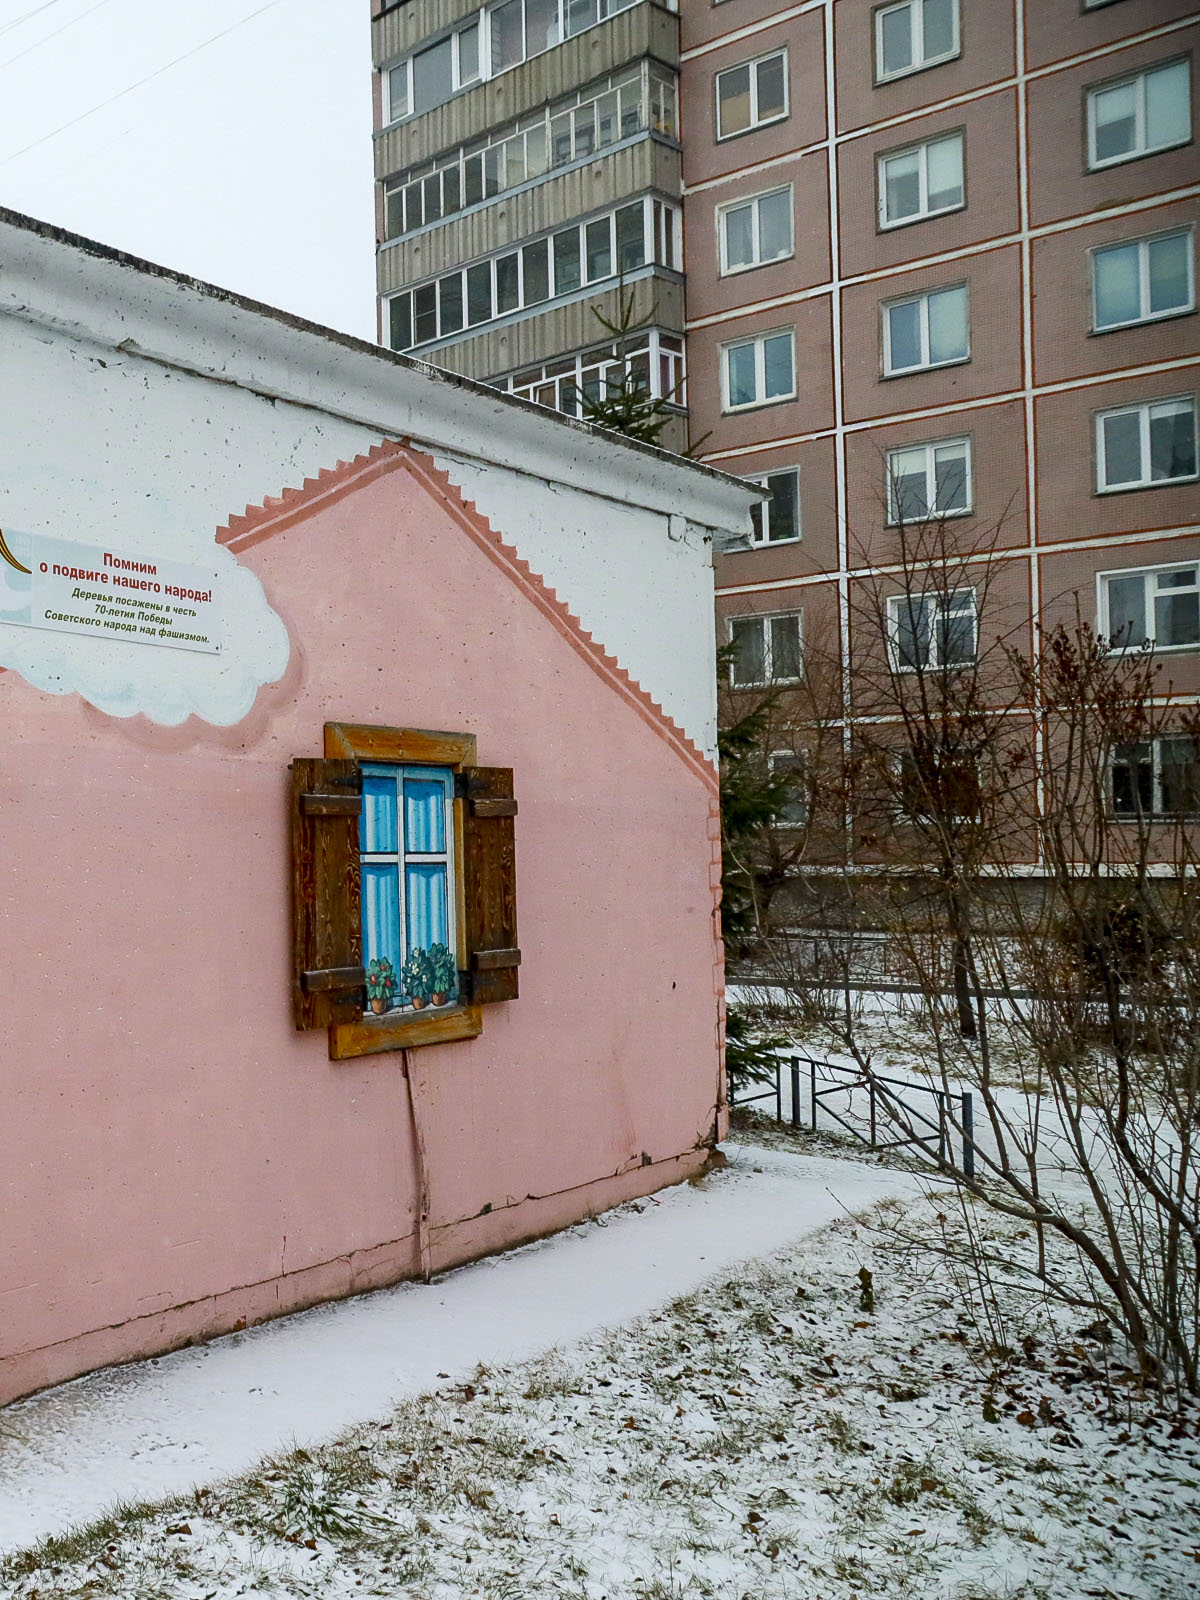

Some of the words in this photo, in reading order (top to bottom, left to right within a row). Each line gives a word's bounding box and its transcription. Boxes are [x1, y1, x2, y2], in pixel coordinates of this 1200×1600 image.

[103, 552, 157, 575] Помним
[39, 562, 48, 573] о
[52, 566, 109, 584] подвиге
[112, 575, 161, 594] нашего
[164, 586, 213, 604] народа!
[72, 587, 113, 603] Деревья
[115, 596, 163, 612] посажены
[165, 604, 170, 612] в
[173, 606, 197, 617] честь
[95, 603, 135, 619] 70-летия
[137, 611, 173, 625] Победы
[44, 609, 101, 627] Советского
[103, 620, 137, 633] народа
[139, 625, 156, 636] над
[158, 627, 210, 644] фашизмом.
